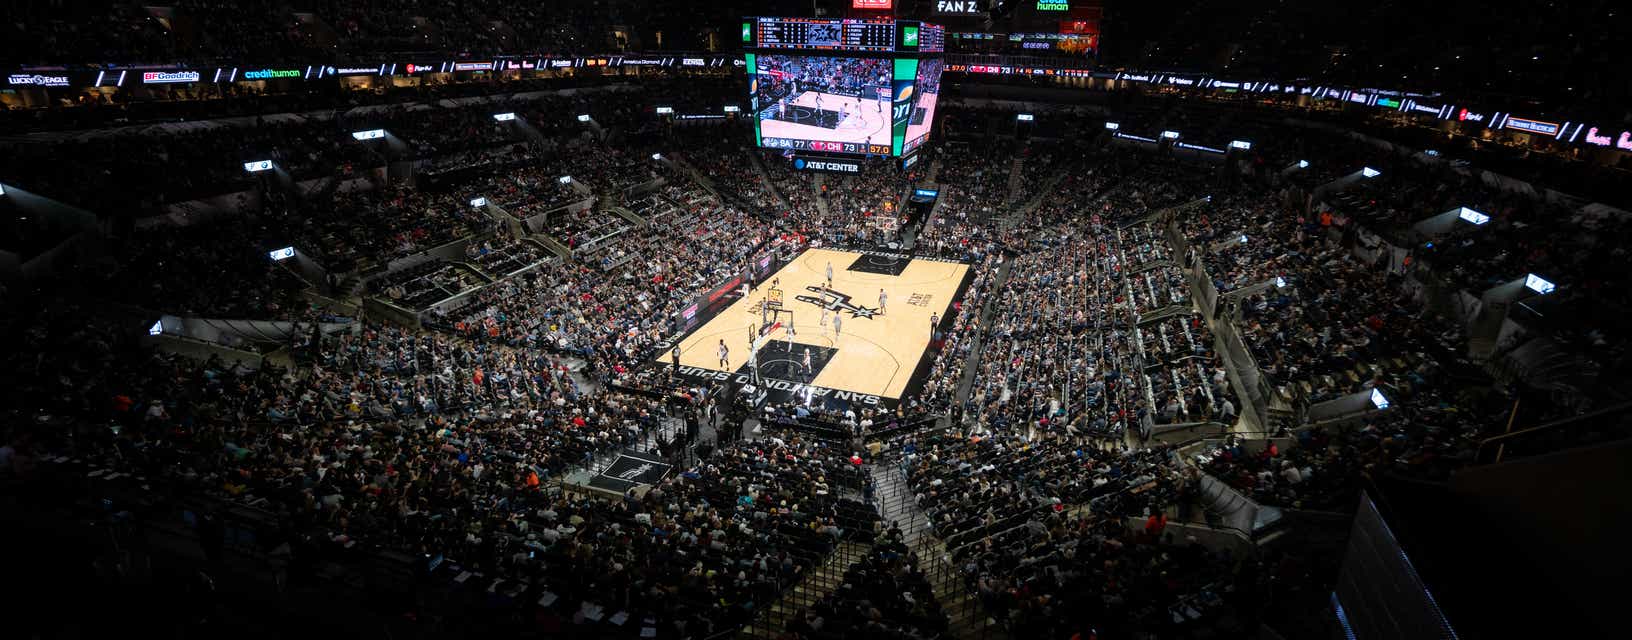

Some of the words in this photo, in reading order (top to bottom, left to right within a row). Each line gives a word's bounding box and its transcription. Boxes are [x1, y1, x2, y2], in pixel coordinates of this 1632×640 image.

[937, 1, 964, 12] FAN
[1037, 2, 1069, 11] human
[144, 72, 200, 82] BFGoodrich
[245, 70, 300, 79] credithuman
[780, 139, 791, 147] SA
[827, 143, 841, 151] CHI
[870, 145, 889, 154] 57.0
[806, 161, 825, 170] AT&T
[827, 163, 858, 172] CENTER
[736, 375, 832, 397] ATONO
[834, 390, 881, 404] SAN
